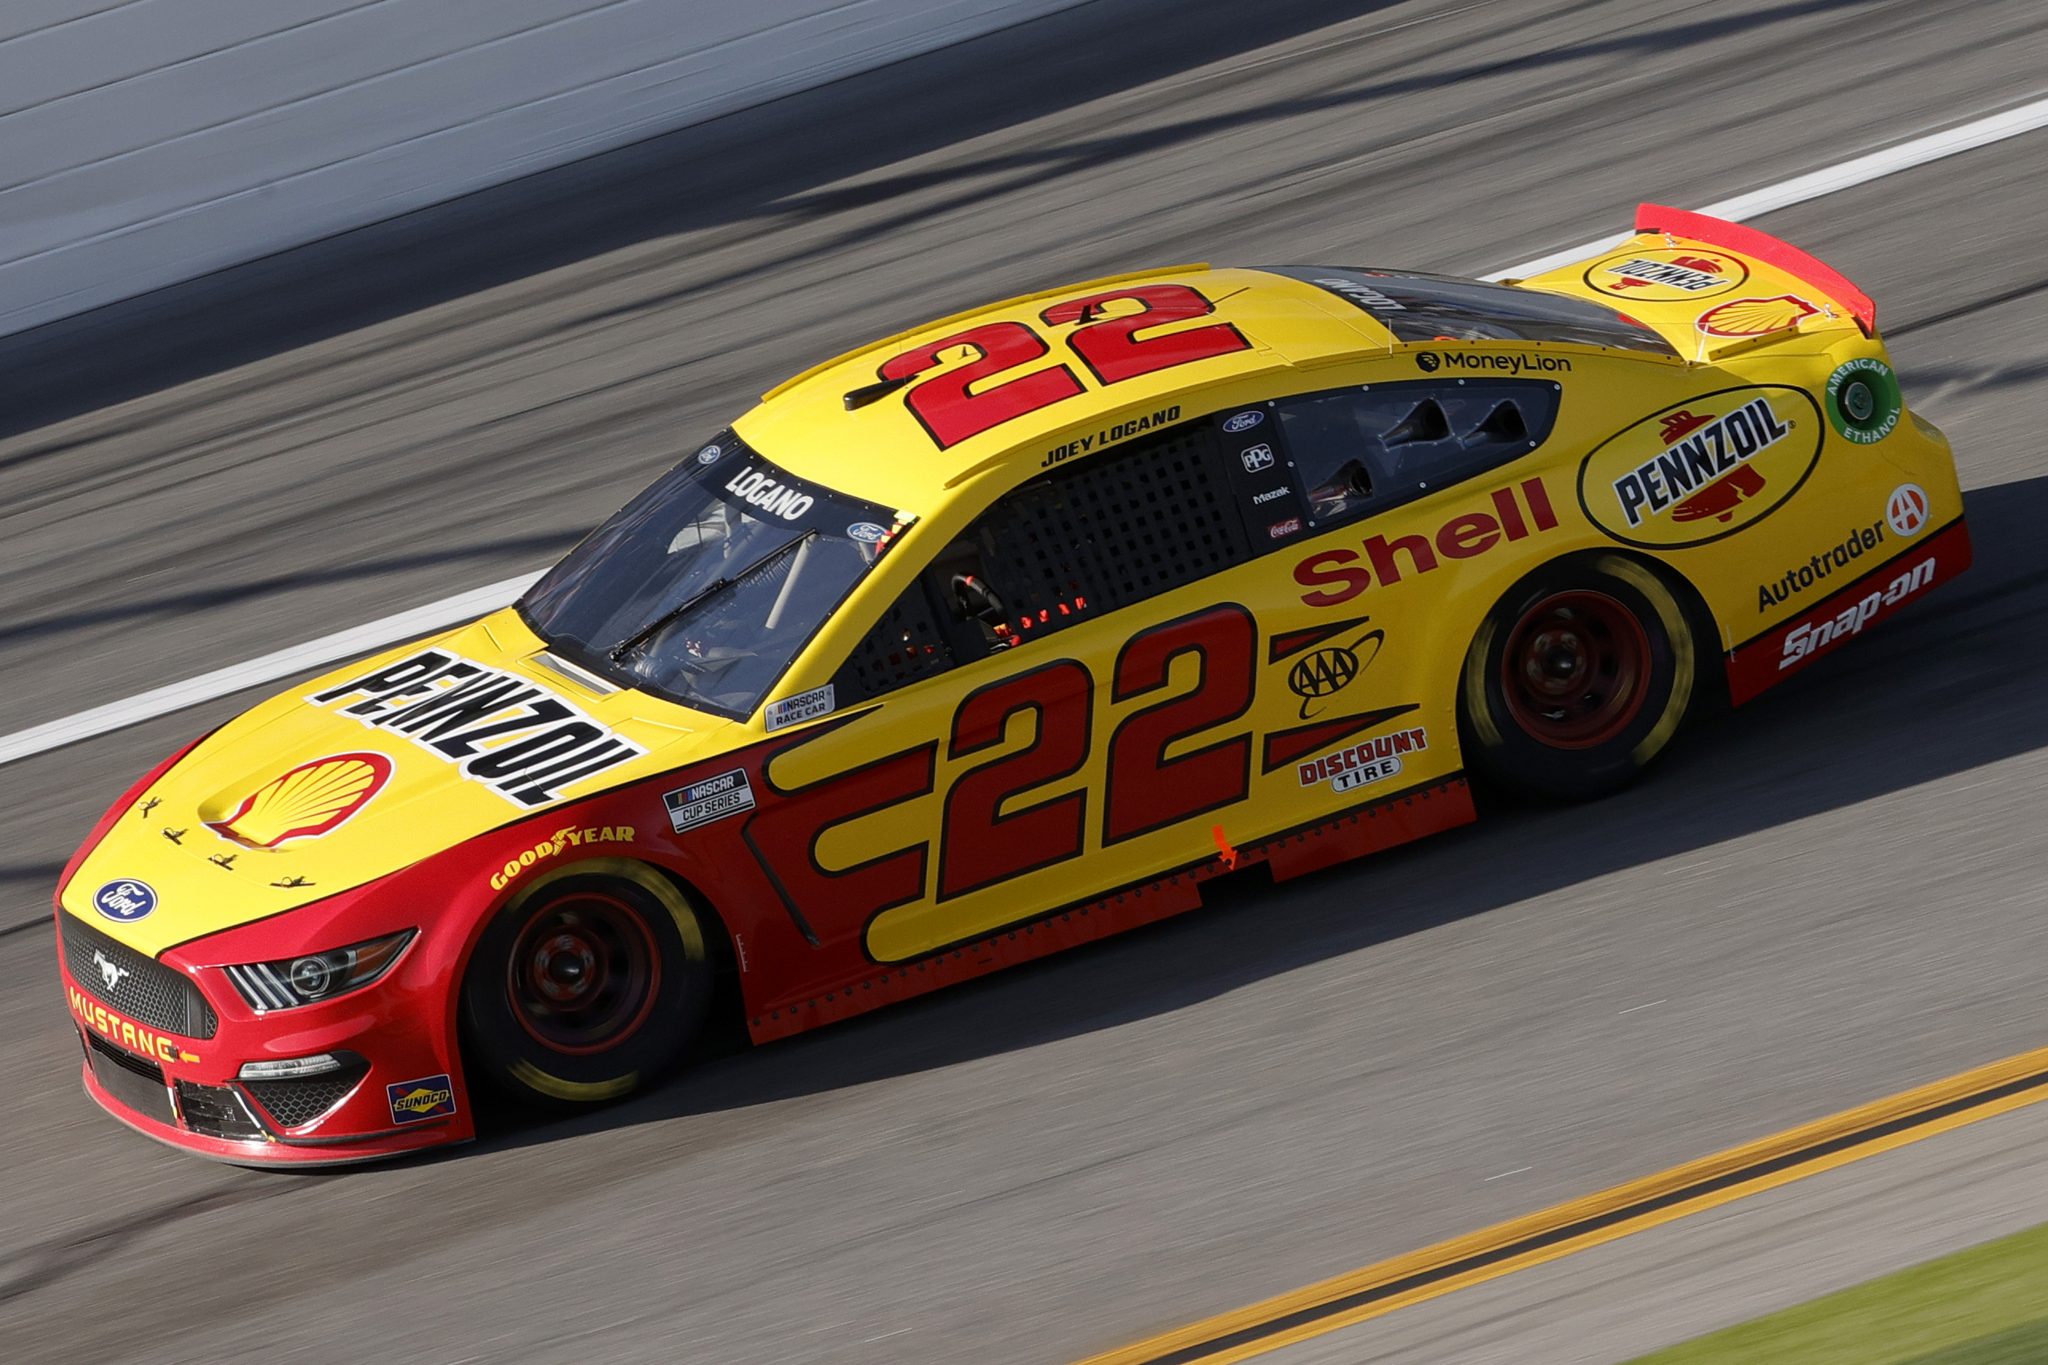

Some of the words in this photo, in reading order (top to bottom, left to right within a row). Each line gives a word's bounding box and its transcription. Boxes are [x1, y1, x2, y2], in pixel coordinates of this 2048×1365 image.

[1606, 258, 1729, 291] PENNZOIL
[876, 284, 1253, 451] 22
[1444, 352, 1572, 374] MoneyLion
[1827, 359, 1888, 396] AMERICAN
[1041, 434, 1096, 468] JOEY
[1099, 405, 1181, 446] LOGANO
[1844, 408, 1900, 443] ETHANOL
[1244, 448, 1271, 468] PPG
[1612, 397, 1788, 528] PENNZOIL
[725, 466, 814, 521] LOGANO
[1253, 486, 1291, 505] Mazak
[1293, 476, 1559, 608] Shell
[1759, 520, 1884, 613] Autotrader
[1299, 650, 1352, 695] AAA
[776, 709, 803, 725] RACE
[804, 703, 826, 716] CAR
[787, 690, 826, 711] NASCAR
[312, 650, 641, 807] PENNZOIL
[937, 600, 1259, 904] 22
[1299, 728, 1427, 785] DISCOUNT
[691, 775, 735, 801] NASCAR
[1338, 761, 1394, 788] TIRE
[682, 801, 705, 821] CUP
[703, 792, 741, 815] SERIES
[101, 883, 147, 916] Ford
[69, 986, 176, 1063] MUSTANG
[396, 1091, 447, 1110] SUNOCO
